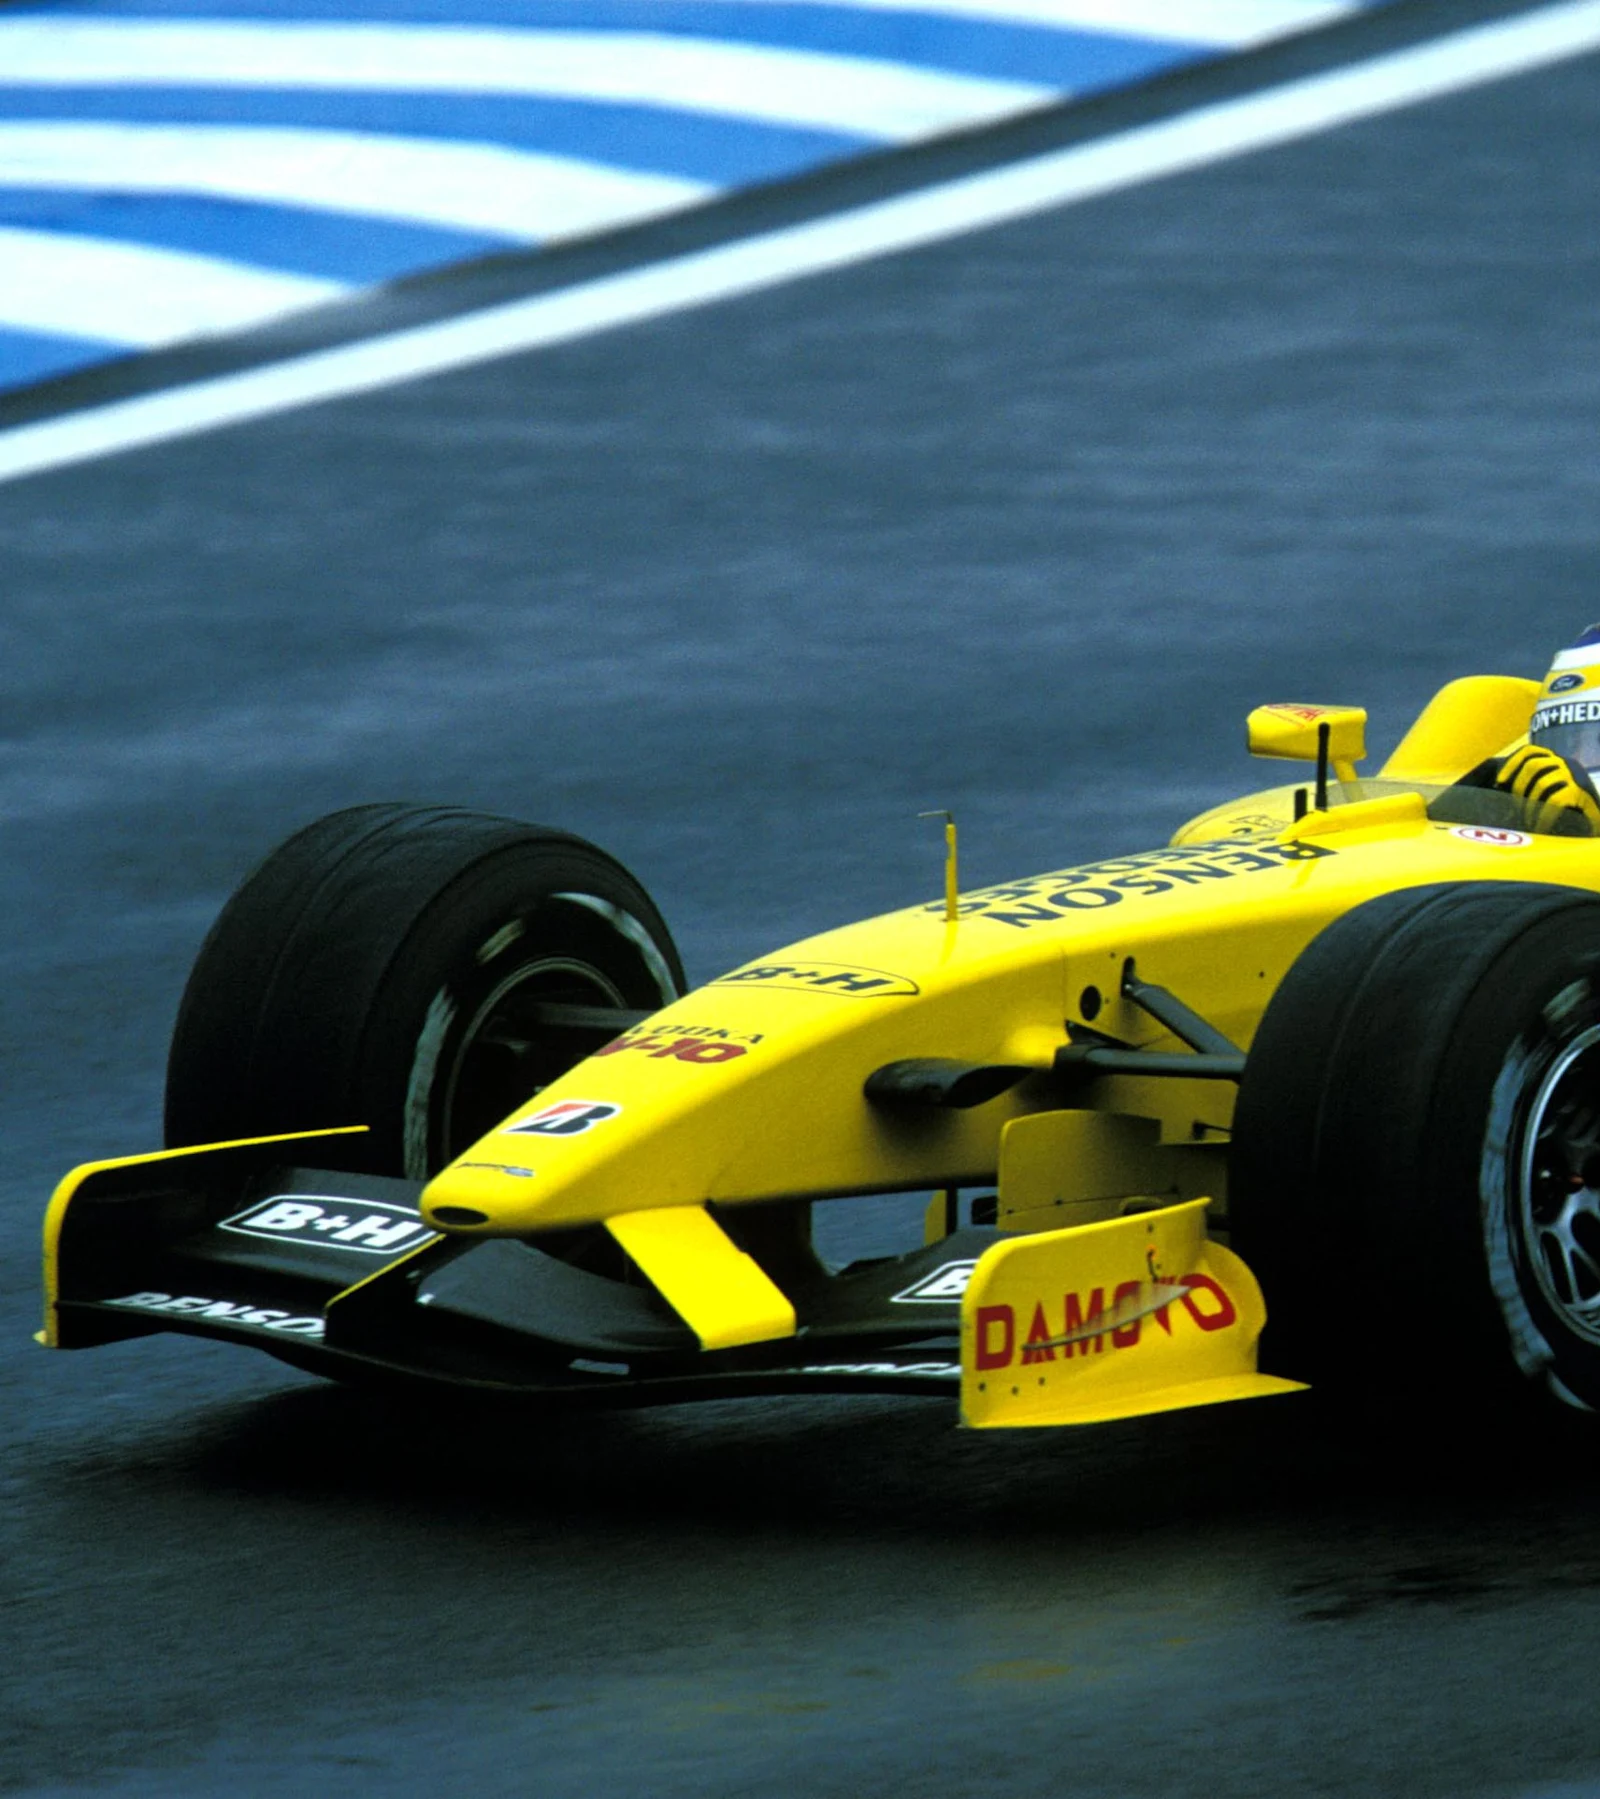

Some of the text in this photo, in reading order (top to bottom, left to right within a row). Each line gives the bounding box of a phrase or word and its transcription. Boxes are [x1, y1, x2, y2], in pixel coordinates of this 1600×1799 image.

[982, 840, 1338, 928] BENSON
[726, 966, 896, 991] B+H
[597, 1036, 748, 1064] V-10
[244, 1201, 424, 1247] B+H
[102, 1291, 326, 1338] BENSO
